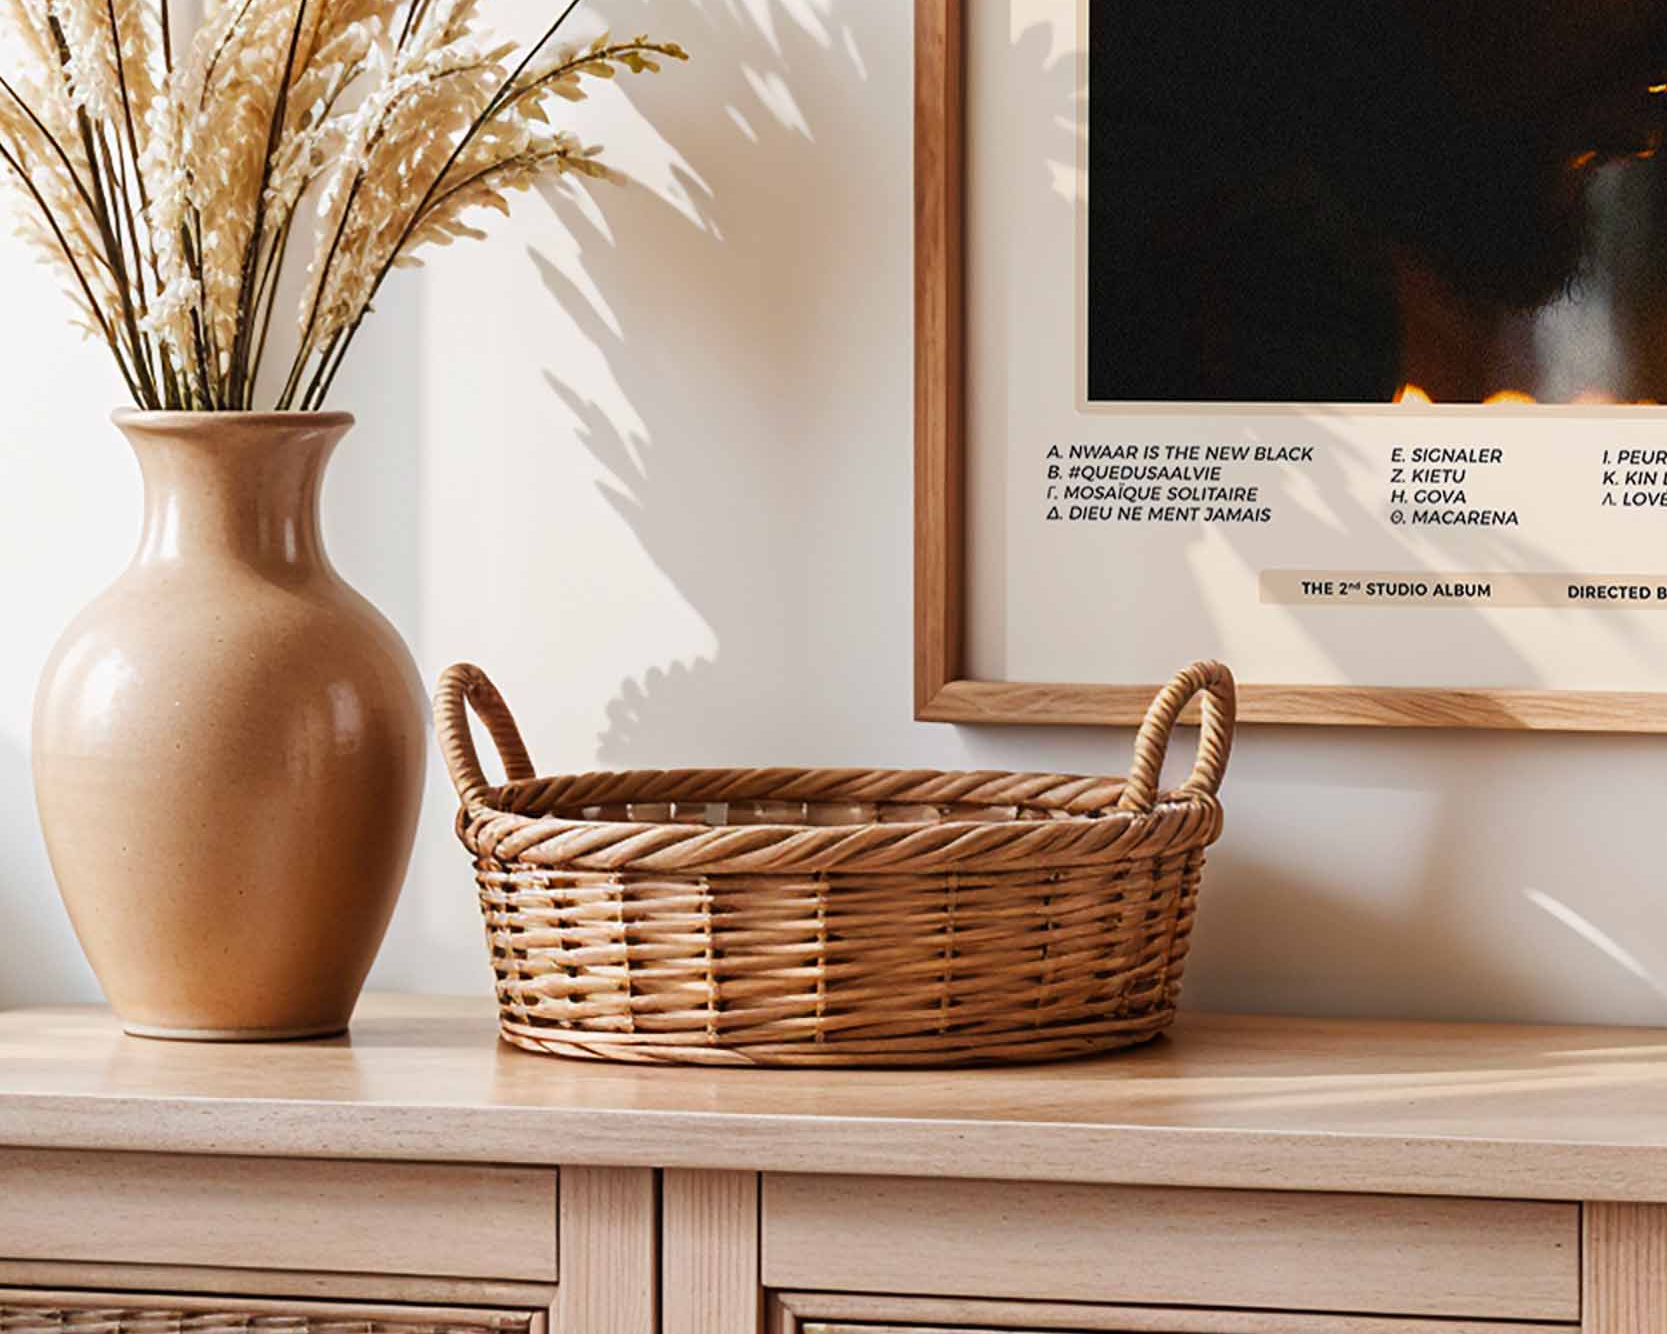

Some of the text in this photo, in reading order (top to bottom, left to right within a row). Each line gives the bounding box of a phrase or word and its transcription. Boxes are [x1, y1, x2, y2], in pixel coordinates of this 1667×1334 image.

[1069, 445, 1138, 460] NWAAR
[1144, 445, 1160, 460] IS
[1165, 445, 1200, 460] THE
[1205, 446, 1250, 461] NEW
[1254, 446, 1314, 461] BLACK
[1391, 448, 1502, 463] E. SIGNALER
[1617, 450, 1667, 465] PEUR
[1048, 465, 1221, 482] B. #QUEDUSAALVIE
[1390, 468, 1466, 484] Z. KIETU
[1602, 471, 1618, 485] K.
[1625, 471, 1658, 485] KIN
[1064, 483, 1162, 503] MOSAÏQUE
[1167, 487, 1258, 502] SOLITAIRE
[1391, 490, 1466, 504] H. GOVA
[1069, 506, 1112, 520] DIEU
[1117, 506, 1143, 521] NE
[1148, 506, 1200, 522] MENT
[1204, 507, 1271, 522] JAMAIS
[1412, 510, 1518, 525] MACARENA
[1302, 581, 1333, 595] THE
[1366, 582, 1427, 596] STUDIO
[1433, 583, 1491, 597] ALBUM
[1568, 585, 1651, 599] DIRECTED
